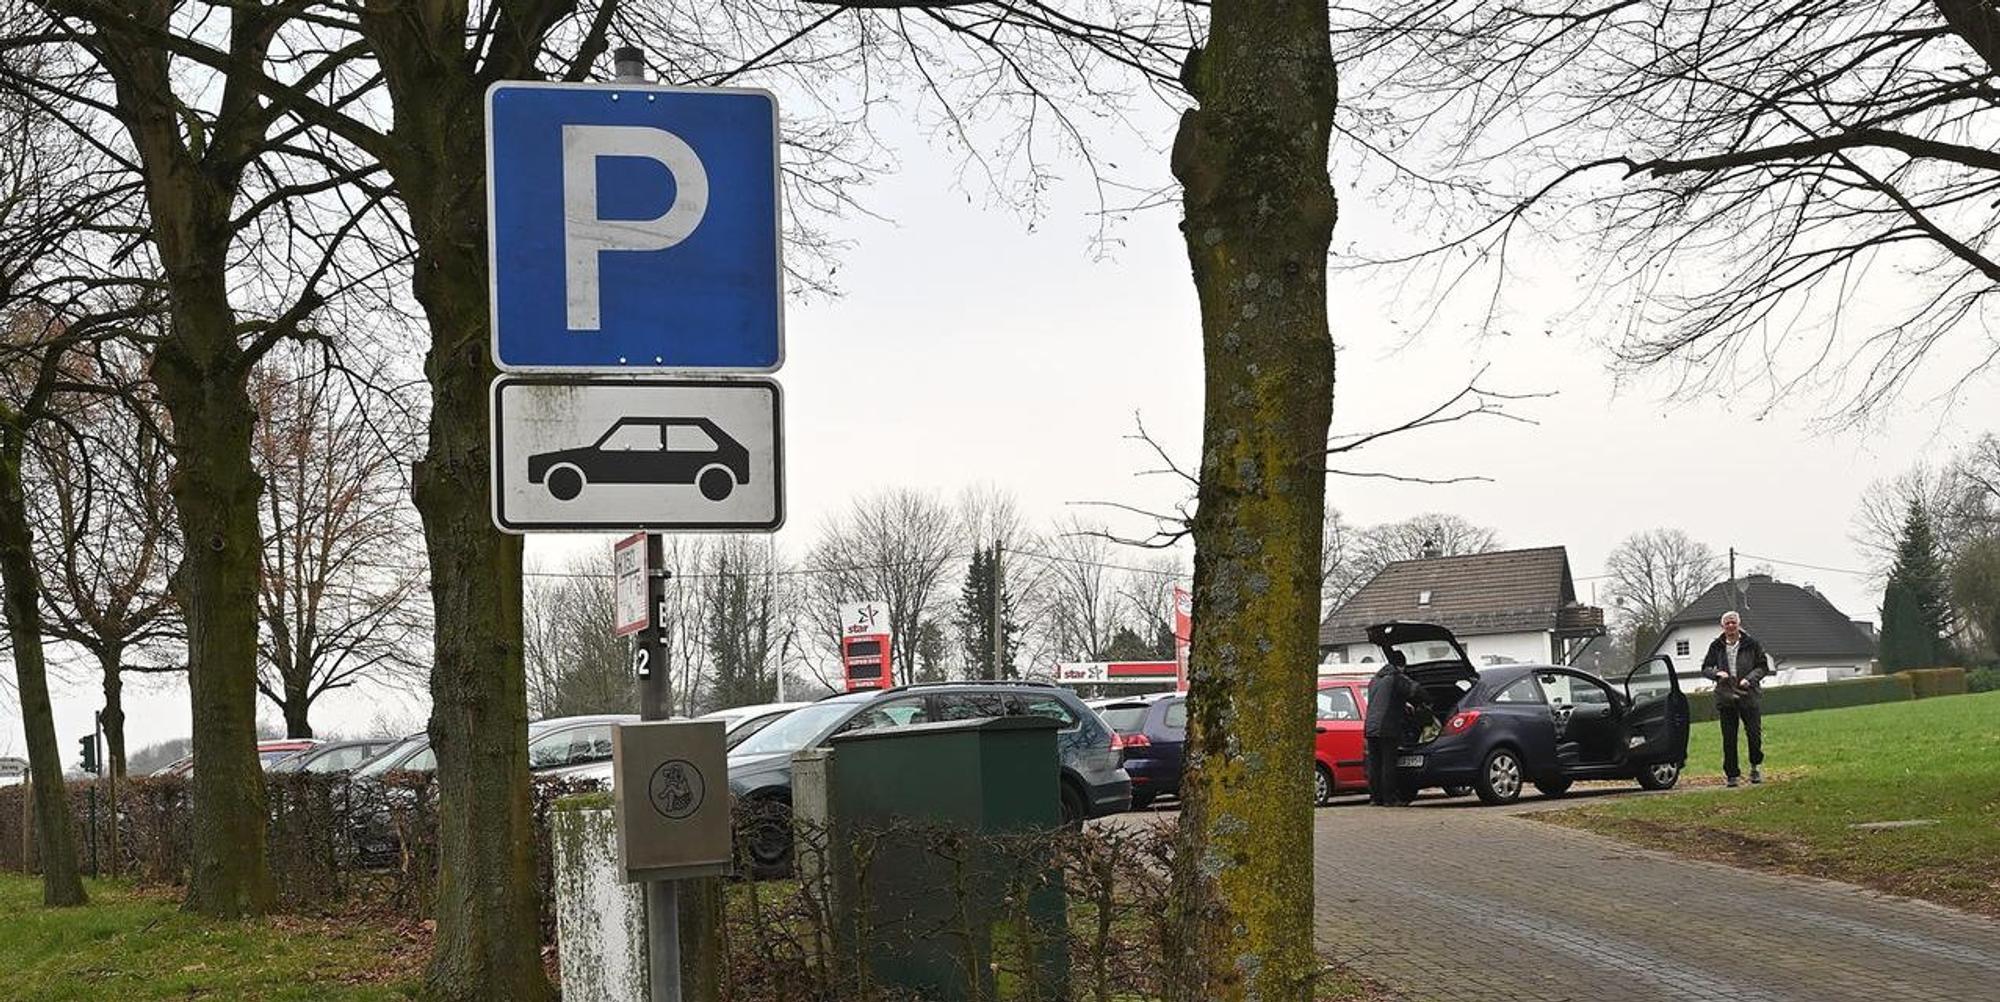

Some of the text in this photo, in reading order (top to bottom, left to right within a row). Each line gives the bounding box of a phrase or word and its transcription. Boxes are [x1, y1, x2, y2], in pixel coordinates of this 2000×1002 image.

[562, 124, 709, 330] P
[848, 624, 868, 633] star
[639, 648, 650, 675] 2
[1064, 670, 1086, 679] star
